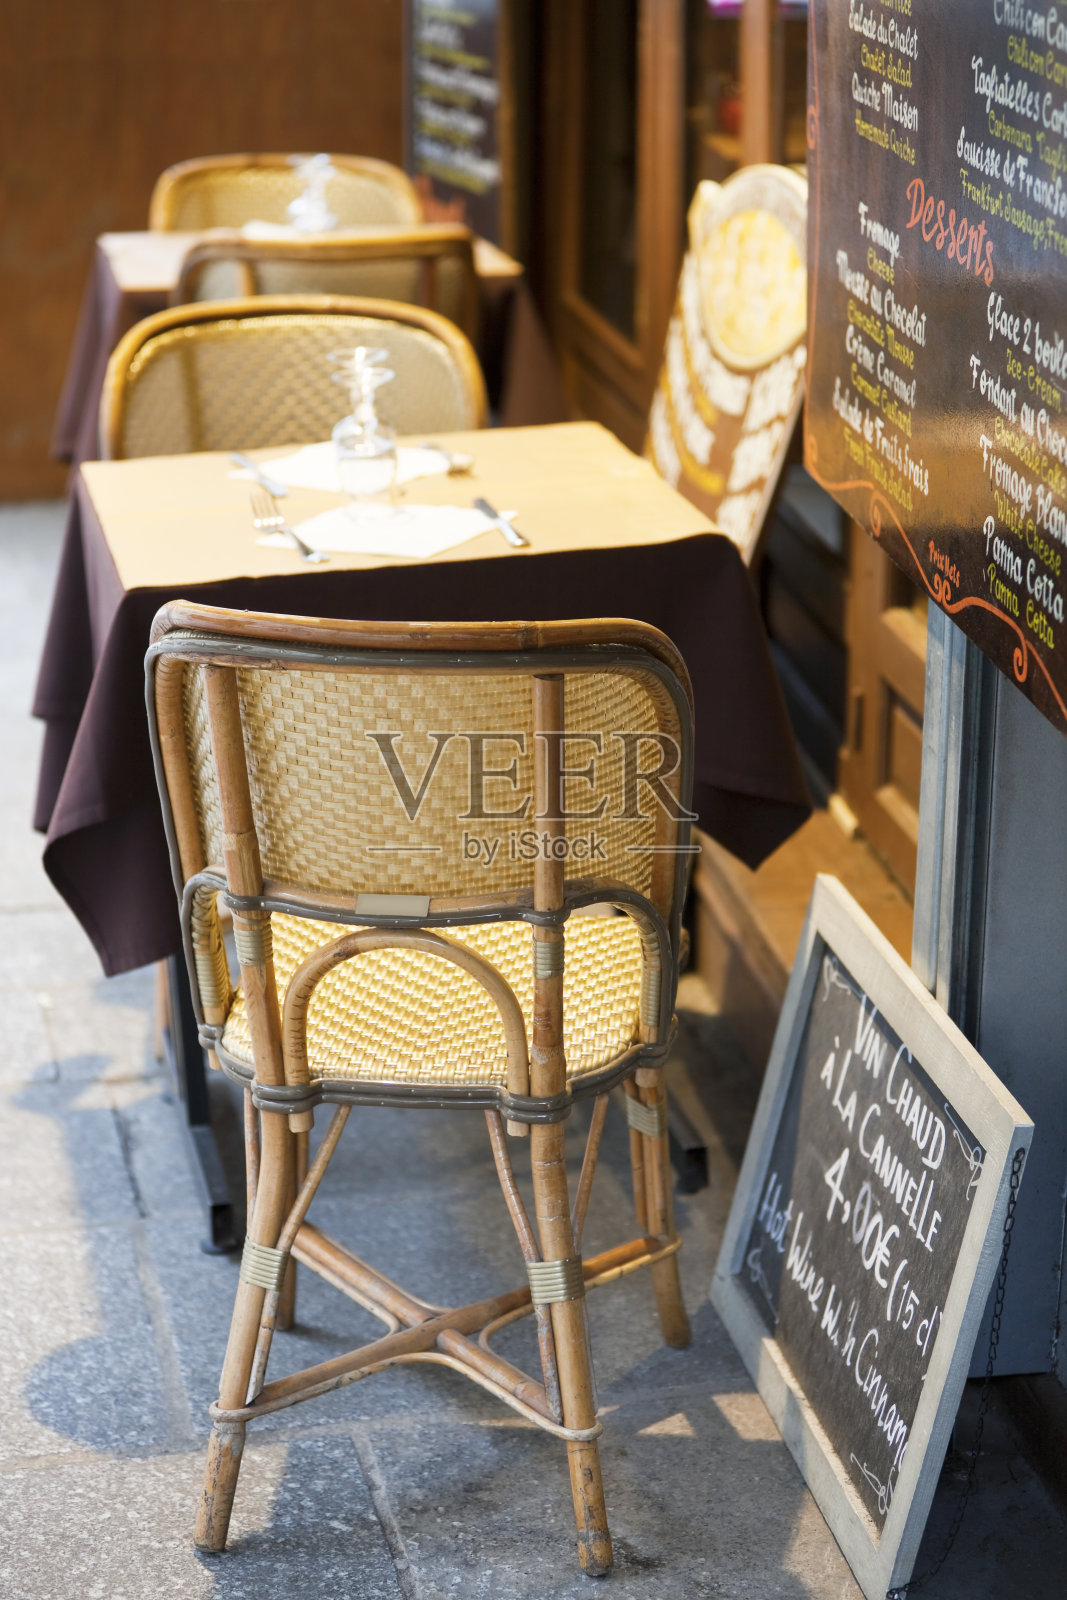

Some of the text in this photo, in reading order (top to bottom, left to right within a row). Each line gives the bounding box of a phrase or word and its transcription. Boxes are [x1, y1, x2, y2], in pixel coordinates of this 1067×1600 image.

[877, 13, 888, 45] du
[888, 17, 918, 60] Chalet
[852, 71, 918, 133] Quiche Maison
[887, 53, 912, 88] Salad
[971, 54, 1040, 122] Tagliatelles
[890, 128, 916, 166] Quiche
[956, 125, 1000, 179] Saucisse
[1003, 150, 1016, 188] de
[960, 167, 1003, 218] Frankfurt
[858, 201, 900, 268] Fromage
[906, 178, 994, 286] Desserts
[867, 247, 895, 285] Cheese
[870, 285, 883, 316] au
[884, 289, 927, 348] Chocolat
[987, 291, 1020, 345] Glace
[1022, 318, 1032, 355] 2
[877, 350, 917, 409] Caramel
[970, 353, 1067, 467] Fondant au Choc
[863, 407, 874, 444] de
[980, 434, 1067, 549] Fromage Blan
[994, 489, 1062, 576] White Cheese
[983, 515, 1065, 624] Panna Cotta
[987, 563, 1055, 649] Panna Cotta
[854, 995, 946, 1170] VIN CHAUD
[858, 1103, 943, 1253] CANNELLE
[758, 1172, 794, 1254] Hot
[786, 1212, 825, 1313] Wine
[916, 1305, 944, 1359] cl
